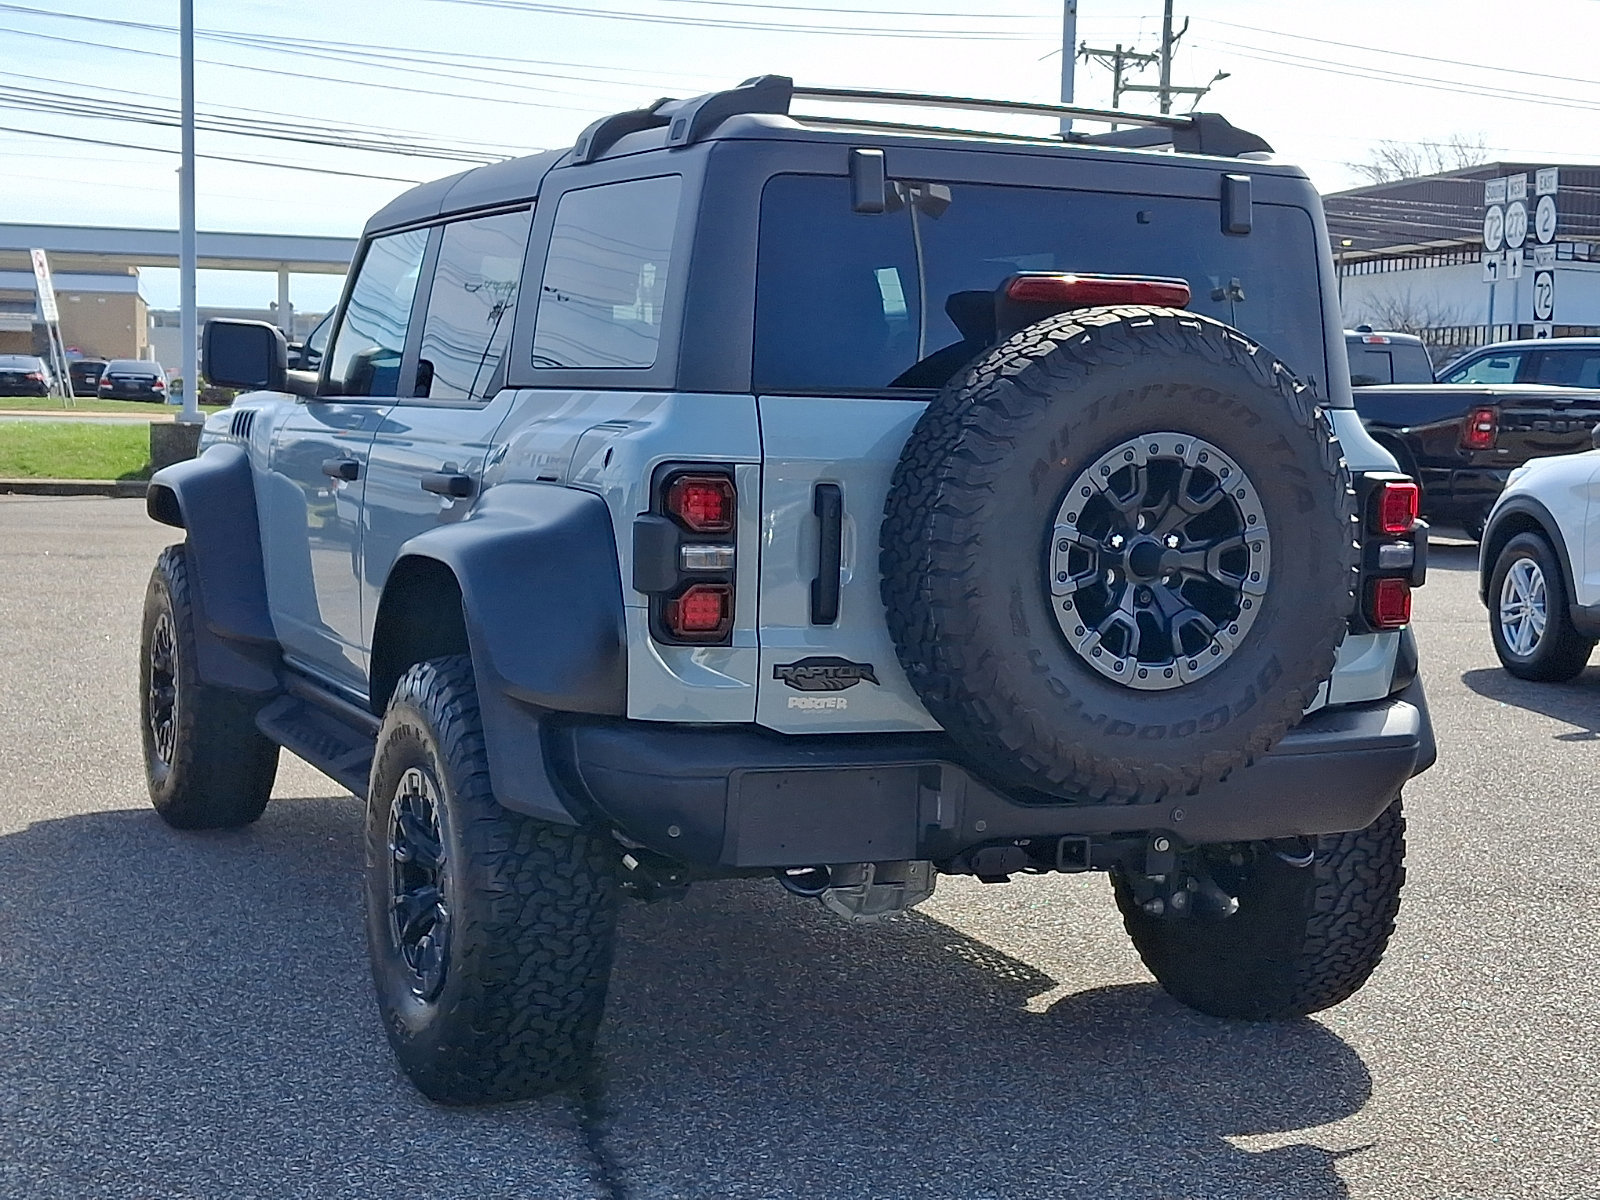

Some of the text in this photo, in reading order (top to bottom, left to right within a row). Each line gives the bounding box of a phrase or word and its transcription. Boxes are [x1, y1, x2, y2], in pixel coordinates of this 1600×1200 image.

[1510, 178, 1525, 196] WEST
[1539, 174, 1553, 190] EAST
[1487, 215, 1502, 242] 72
[1507, 212, 1525, 239] 273
[1542, 208, 1551, 233] 2
[1536, 283, 1552, 309] 72
[775, 665, 881, 688] RAPTOR
[787, 696, 848, 710] PORTER
